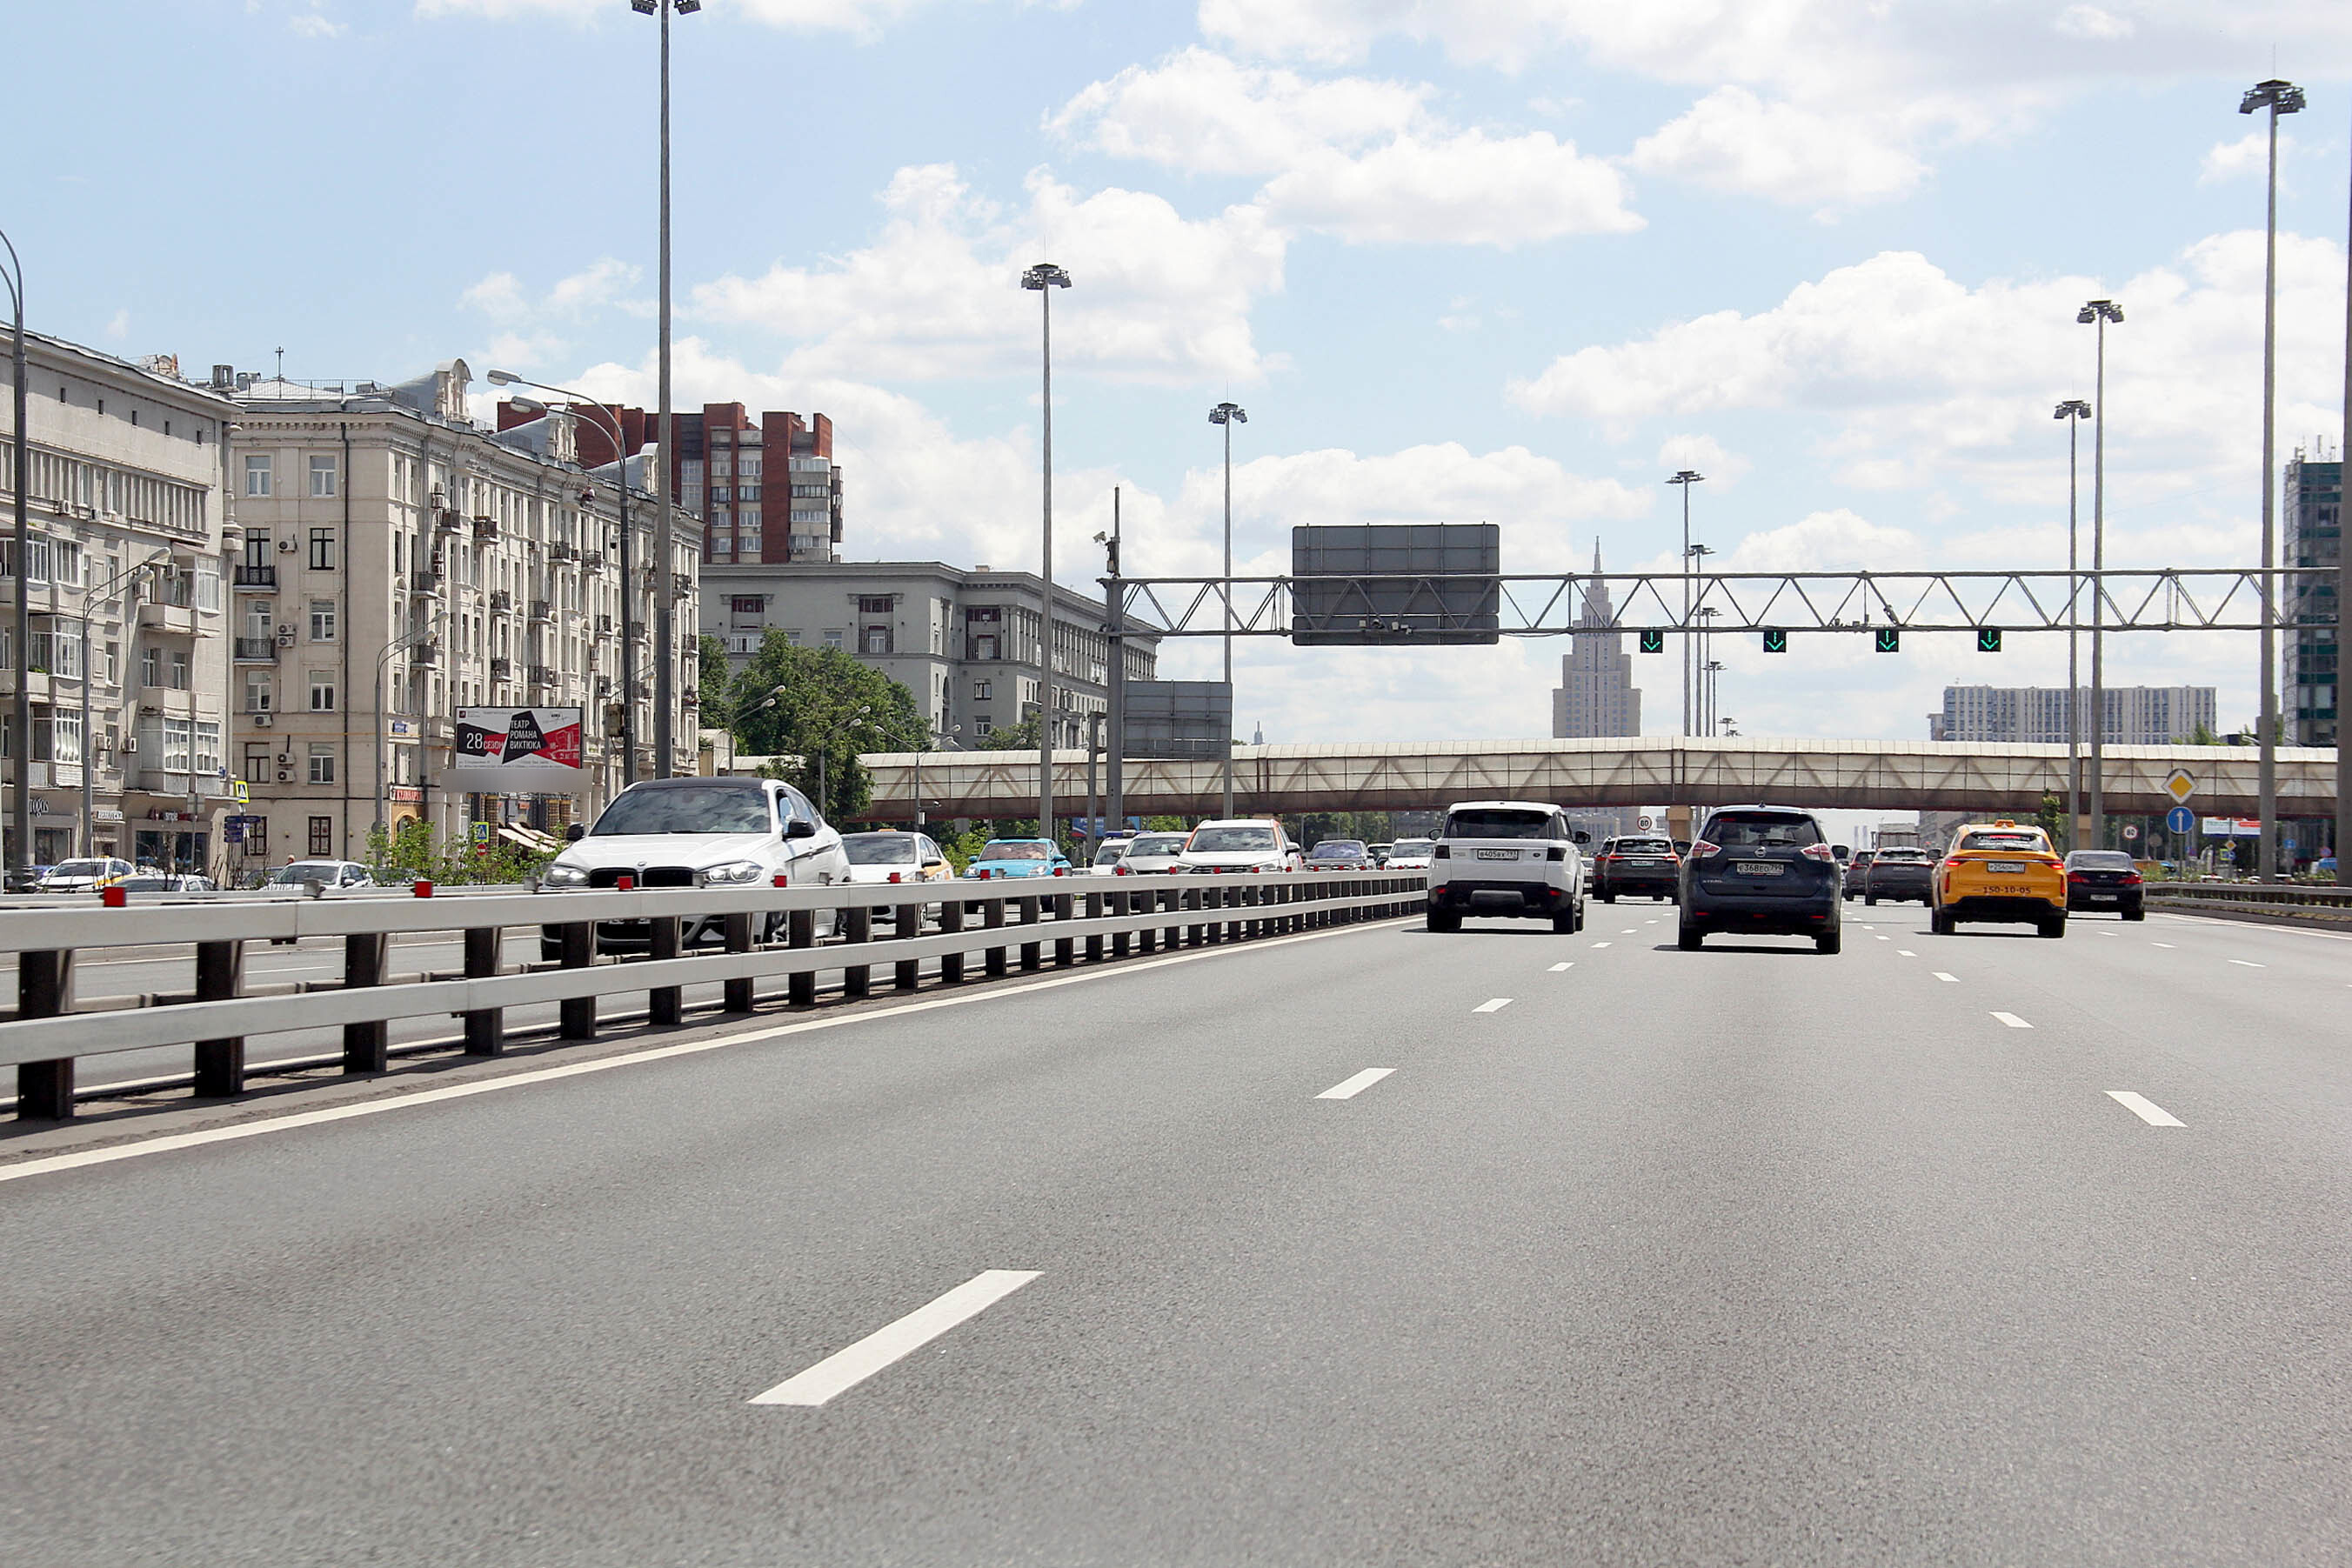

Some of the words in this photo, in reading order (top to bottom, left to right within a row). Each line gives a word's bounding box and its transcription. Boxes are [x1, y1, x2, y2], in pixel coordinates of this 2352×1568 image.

[511, 719, 530, 729] ТЕАТР
[510, 730, 538, 739] РОМАНА
[466, 732, 483, 750] 28
[483, 740, 503, 750] СЕЗОН
[510, 740, 541, 750] ВИКТЮКА
